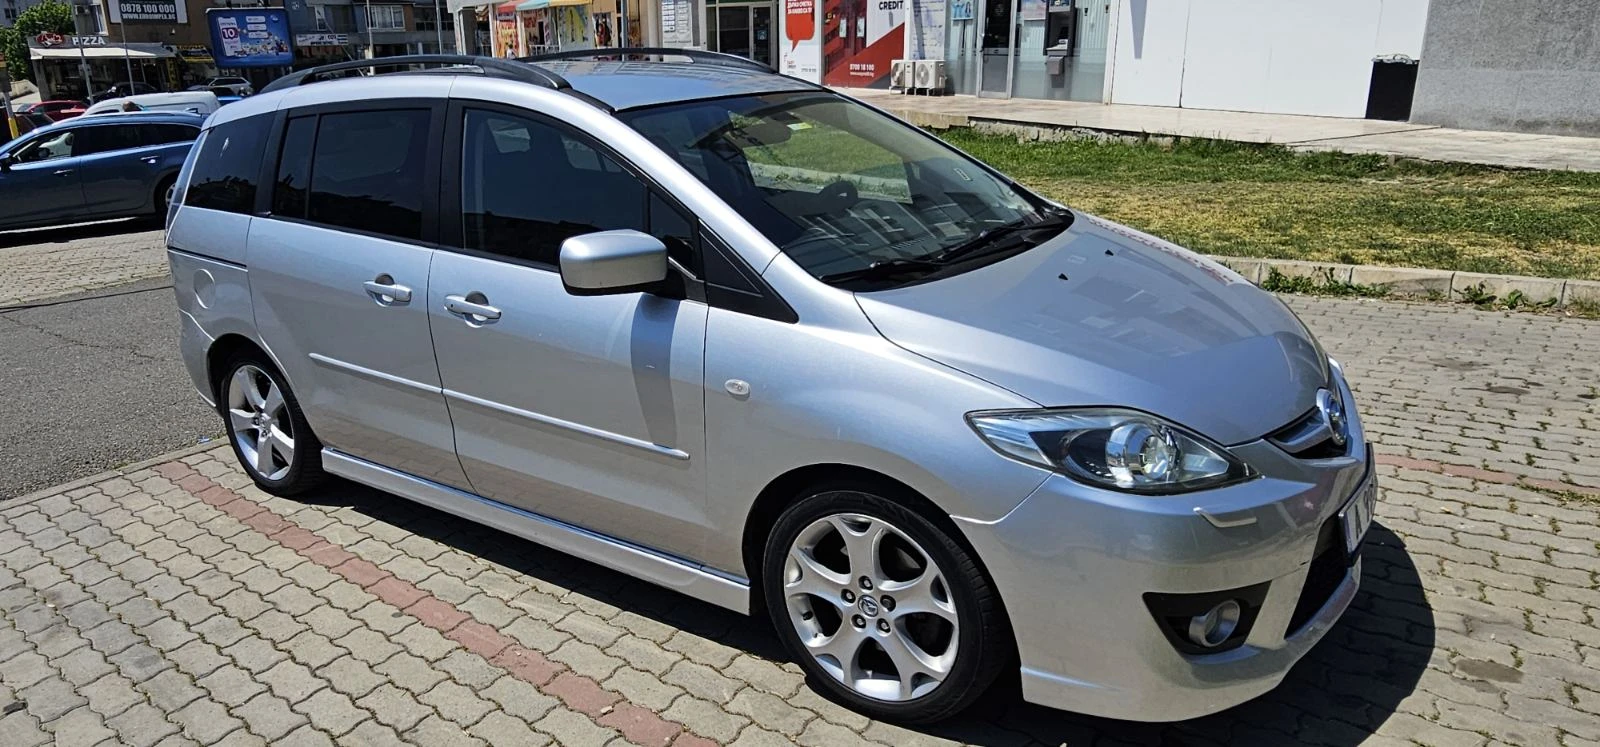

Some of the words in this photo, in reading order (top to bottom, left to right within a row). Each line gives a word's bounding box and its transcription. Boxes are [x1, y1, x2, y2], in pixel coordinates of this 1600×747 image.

[120, 3, 141, 13] 0878
[142, 4, 158, 13] 100
[158, 4, 175, 13] 000
[879, 0, 904, 10] CREDIT
[222, 28, 235, 38] 10
[72, 36, 106, 46] PIZZA
[849, 63, 860, 71] 0700
[860, 63, 866, 71] 18
[866, 63, 875, 71] 100
[1354, 503, 1363, 540] A
